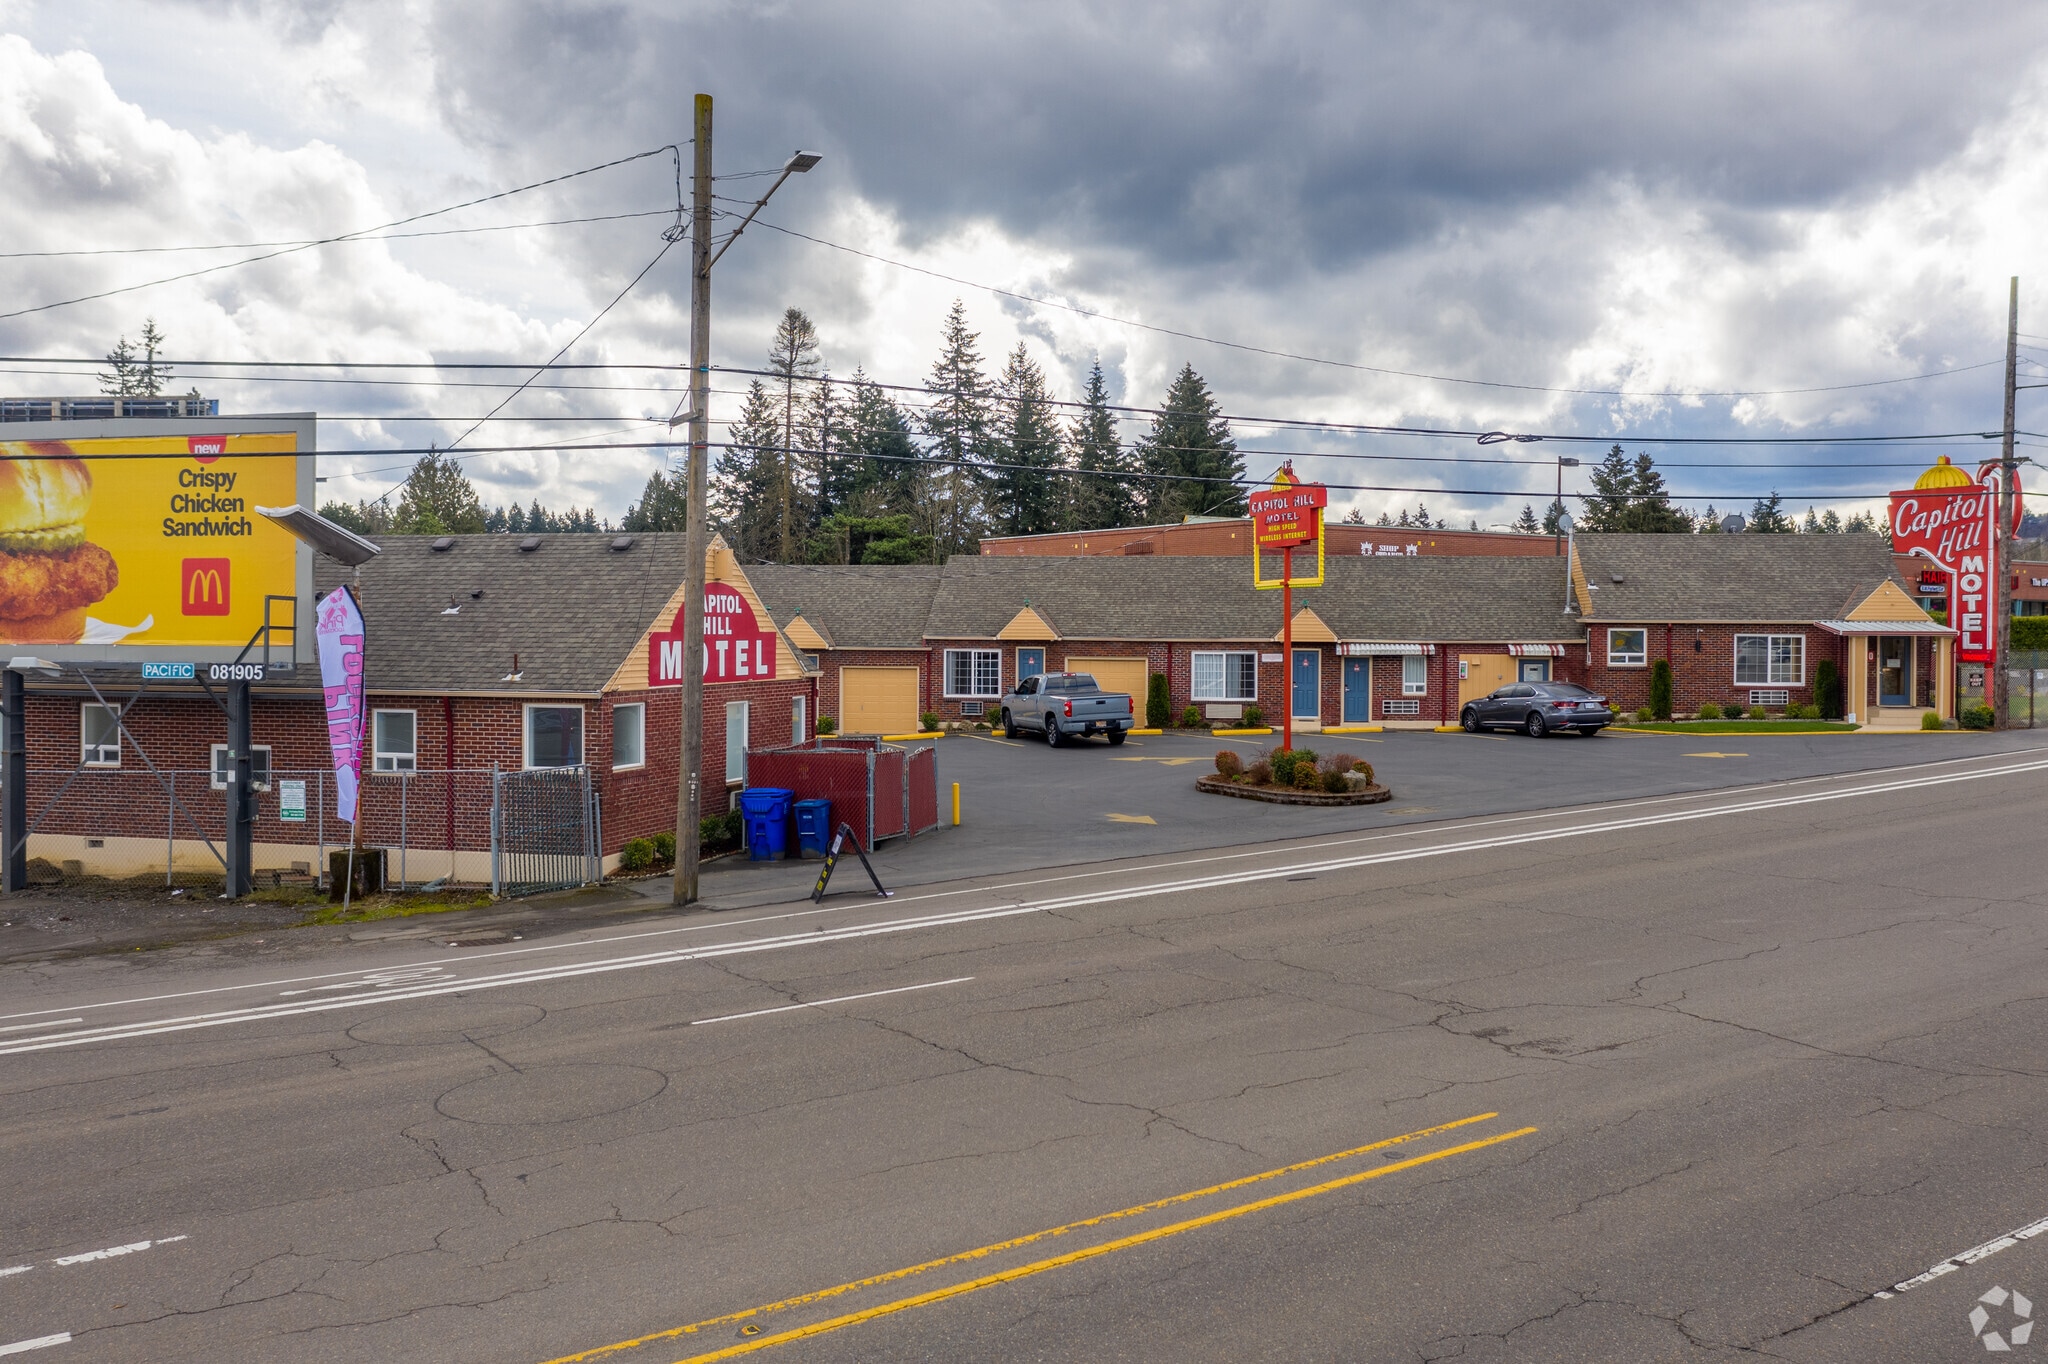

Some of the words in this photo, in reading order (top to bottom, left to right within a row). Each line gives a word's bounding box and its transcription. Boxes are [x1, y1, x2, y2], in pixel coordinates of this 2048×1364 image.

[194, 443, 220, 454] new
[178, 466, 237, 492] Crispy
[170, 492, 244, 514] Chicken
[1251, 498, 1289, 513] CAPITOL
[1294, 494, 1314, 507] HILL
[1265, 512, 1299, 524] MOTEL
[1895, 490, 1986, 539] Capitol
[162, 515, 252, 537] Sandwich
[1268, 524, 1281, 532] HIGH
[1282, 522, 1297, 531] SPEED
[1259, 533, 1282, 542] WIRELESS
[1283, 530, 1307, 540] INTERNET
[1936, 520, 1984, 562] Hill
[1923, 571, 1947, 583] HAIR
[704, 594, 742, 614] APITOL
[1960, 555, 1984, 650] MOTEL
[703, 616, 733, 635] HILL
[660, 640, 768, 680] MTEL
[210, 664, 263, 680] 081905
